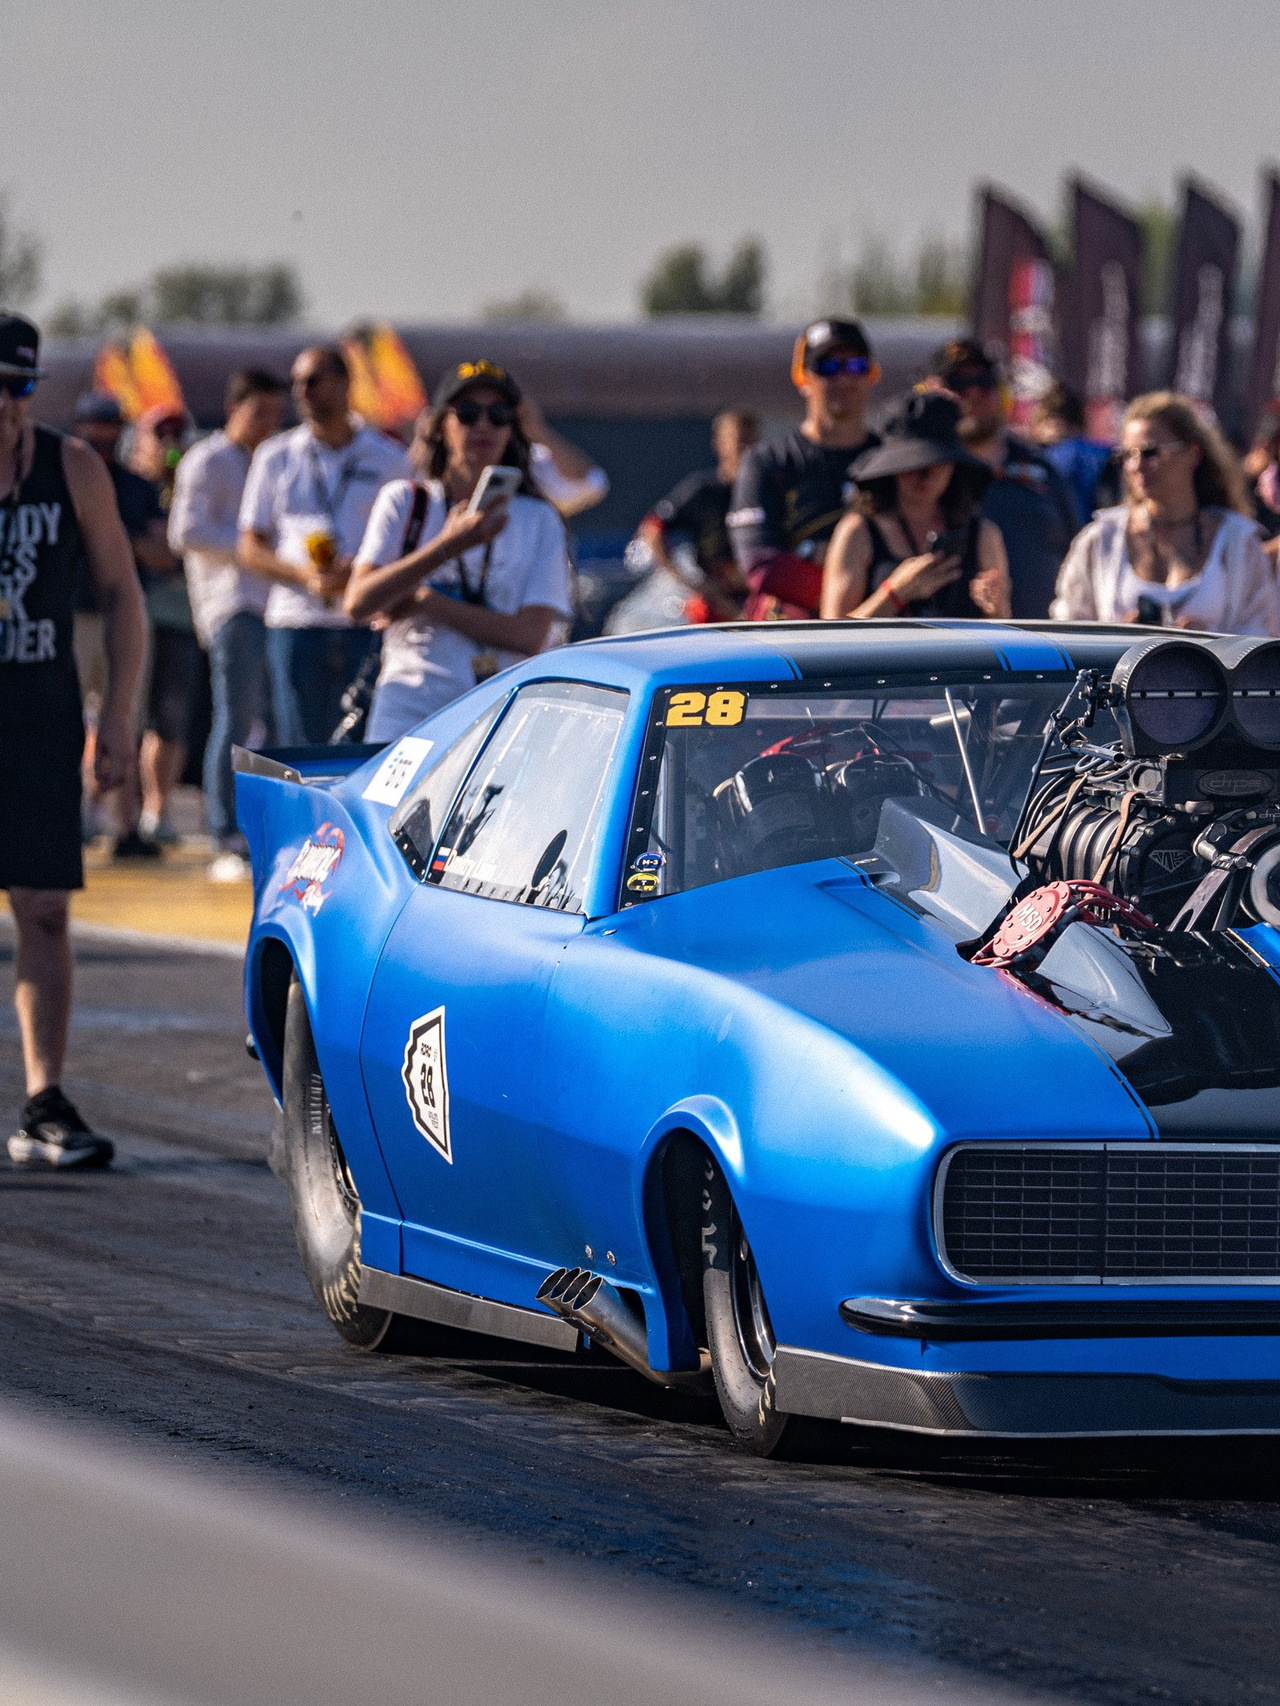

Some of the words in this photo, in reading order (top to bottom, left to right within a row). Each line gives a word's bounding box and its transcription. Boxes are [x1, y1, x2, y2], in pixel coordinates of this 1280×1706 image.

[665, 691, 746, 727] 28
[1014, 902, 1044, 933] MSD
[420, 1063, 436, 1109] 28
